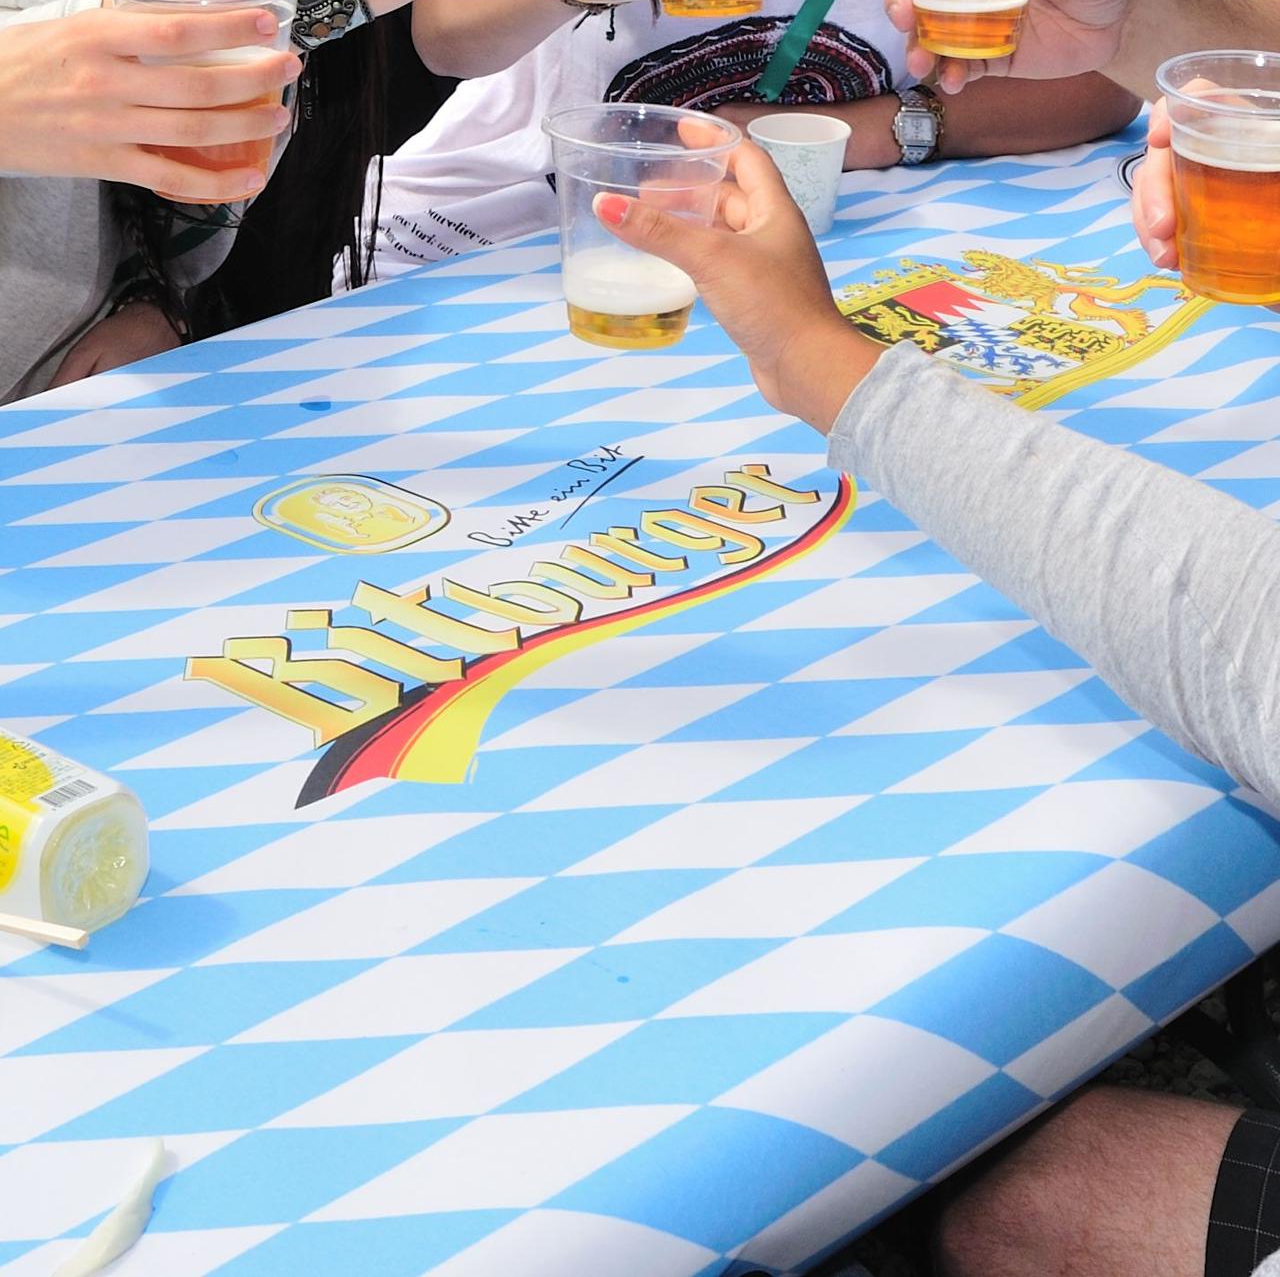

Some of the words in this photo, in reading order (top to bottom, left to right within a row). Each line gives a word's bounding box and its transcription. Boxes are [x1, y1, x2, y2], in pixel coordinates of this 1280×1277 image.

[566, 444, 624, 474] Bit
[550, 478, 591, 503] ein
[467, 507, 550, 548] Bitte
[182, 462, 821, 749] Bitburger
